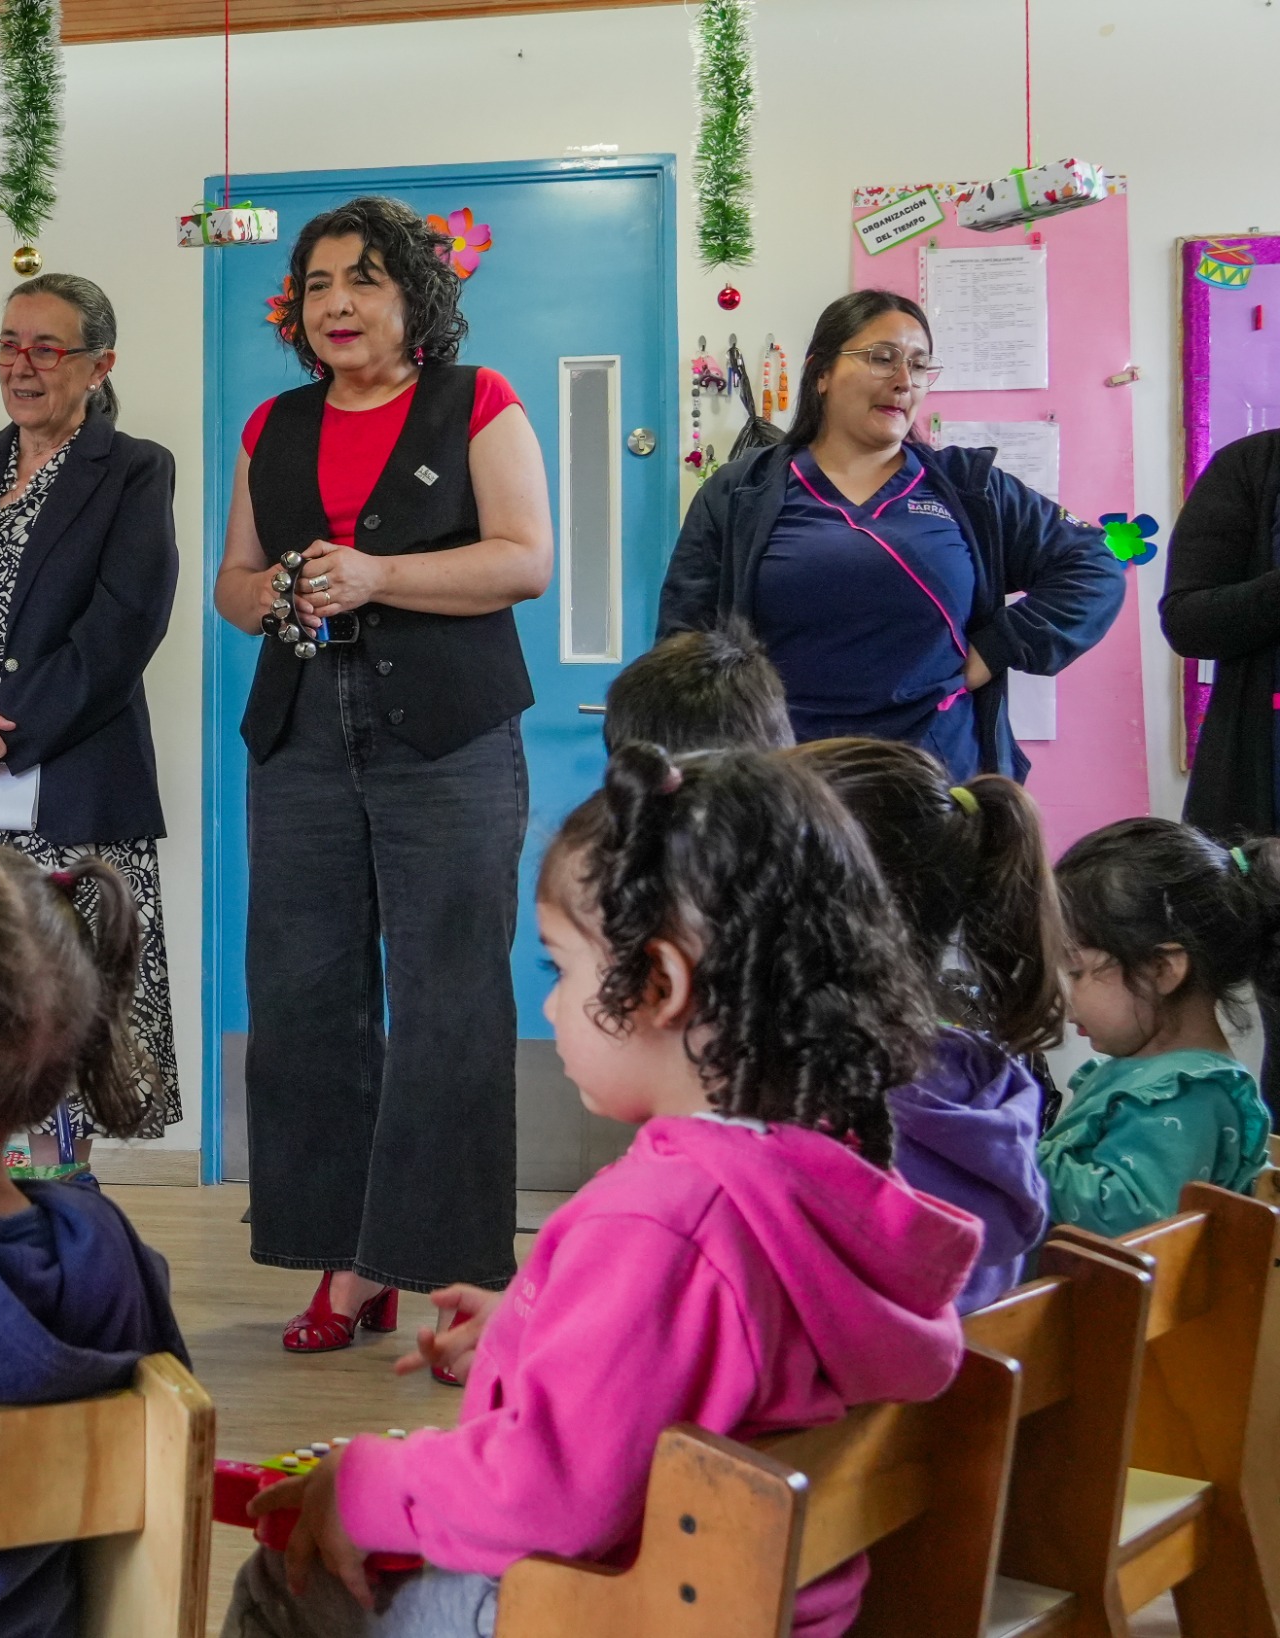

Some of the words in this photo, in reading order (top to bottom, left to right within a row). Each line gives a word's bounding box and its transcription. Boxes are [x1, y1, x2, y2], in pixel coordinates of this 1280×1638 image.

[862, 199, 927, 234] ORGANIZACIÓN
[875, 232, 892, 244] DEL
[893, 216, 926, 235] TIEMPO
